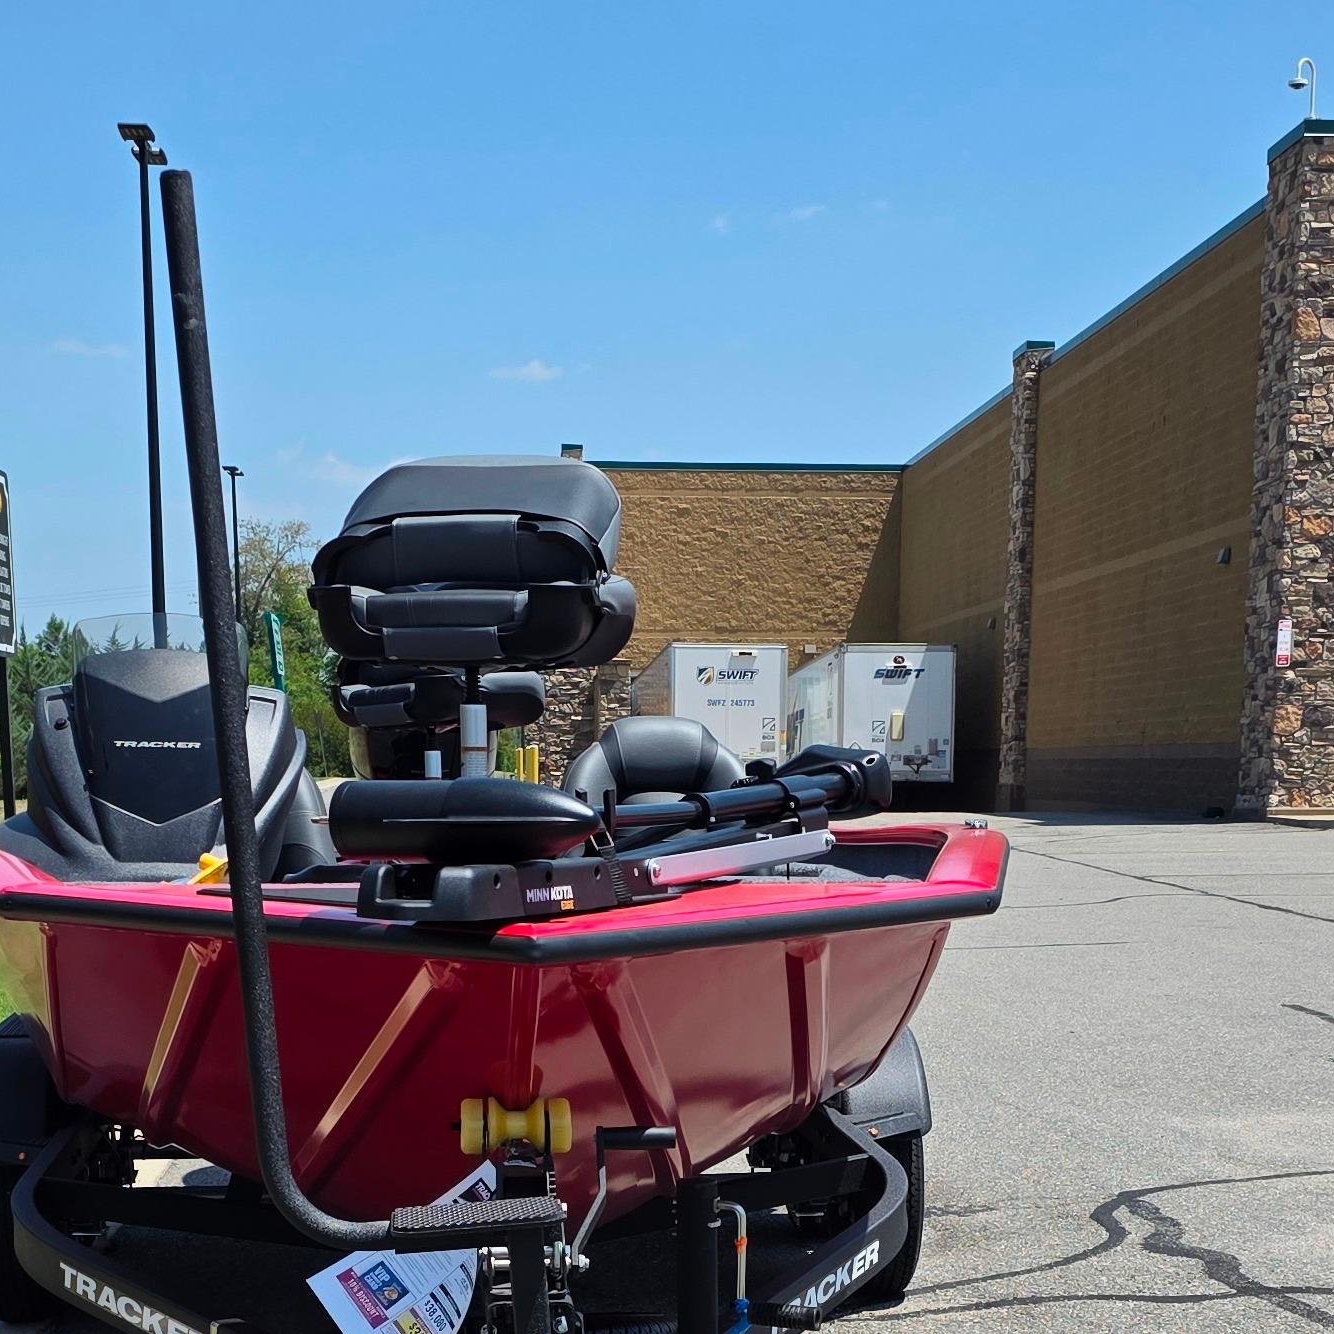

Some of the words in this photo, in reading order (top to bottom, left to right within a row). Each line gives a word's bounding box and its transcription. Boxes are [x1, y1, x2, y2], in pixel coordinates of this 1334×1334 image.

[717, 669, 758, 680] SWIFT
[873, 668, 925, 680] SWIFT
[730, 699, 755, 707] 245773
[113, 740, 202, 749] TRACKER
[526, 887, 550, 903] MINN
[550, 885, 574, 900] KOTA
[374, 1265, 391, 1282] VIP
[356, 1290, 380, 1319] DISCOUNT
